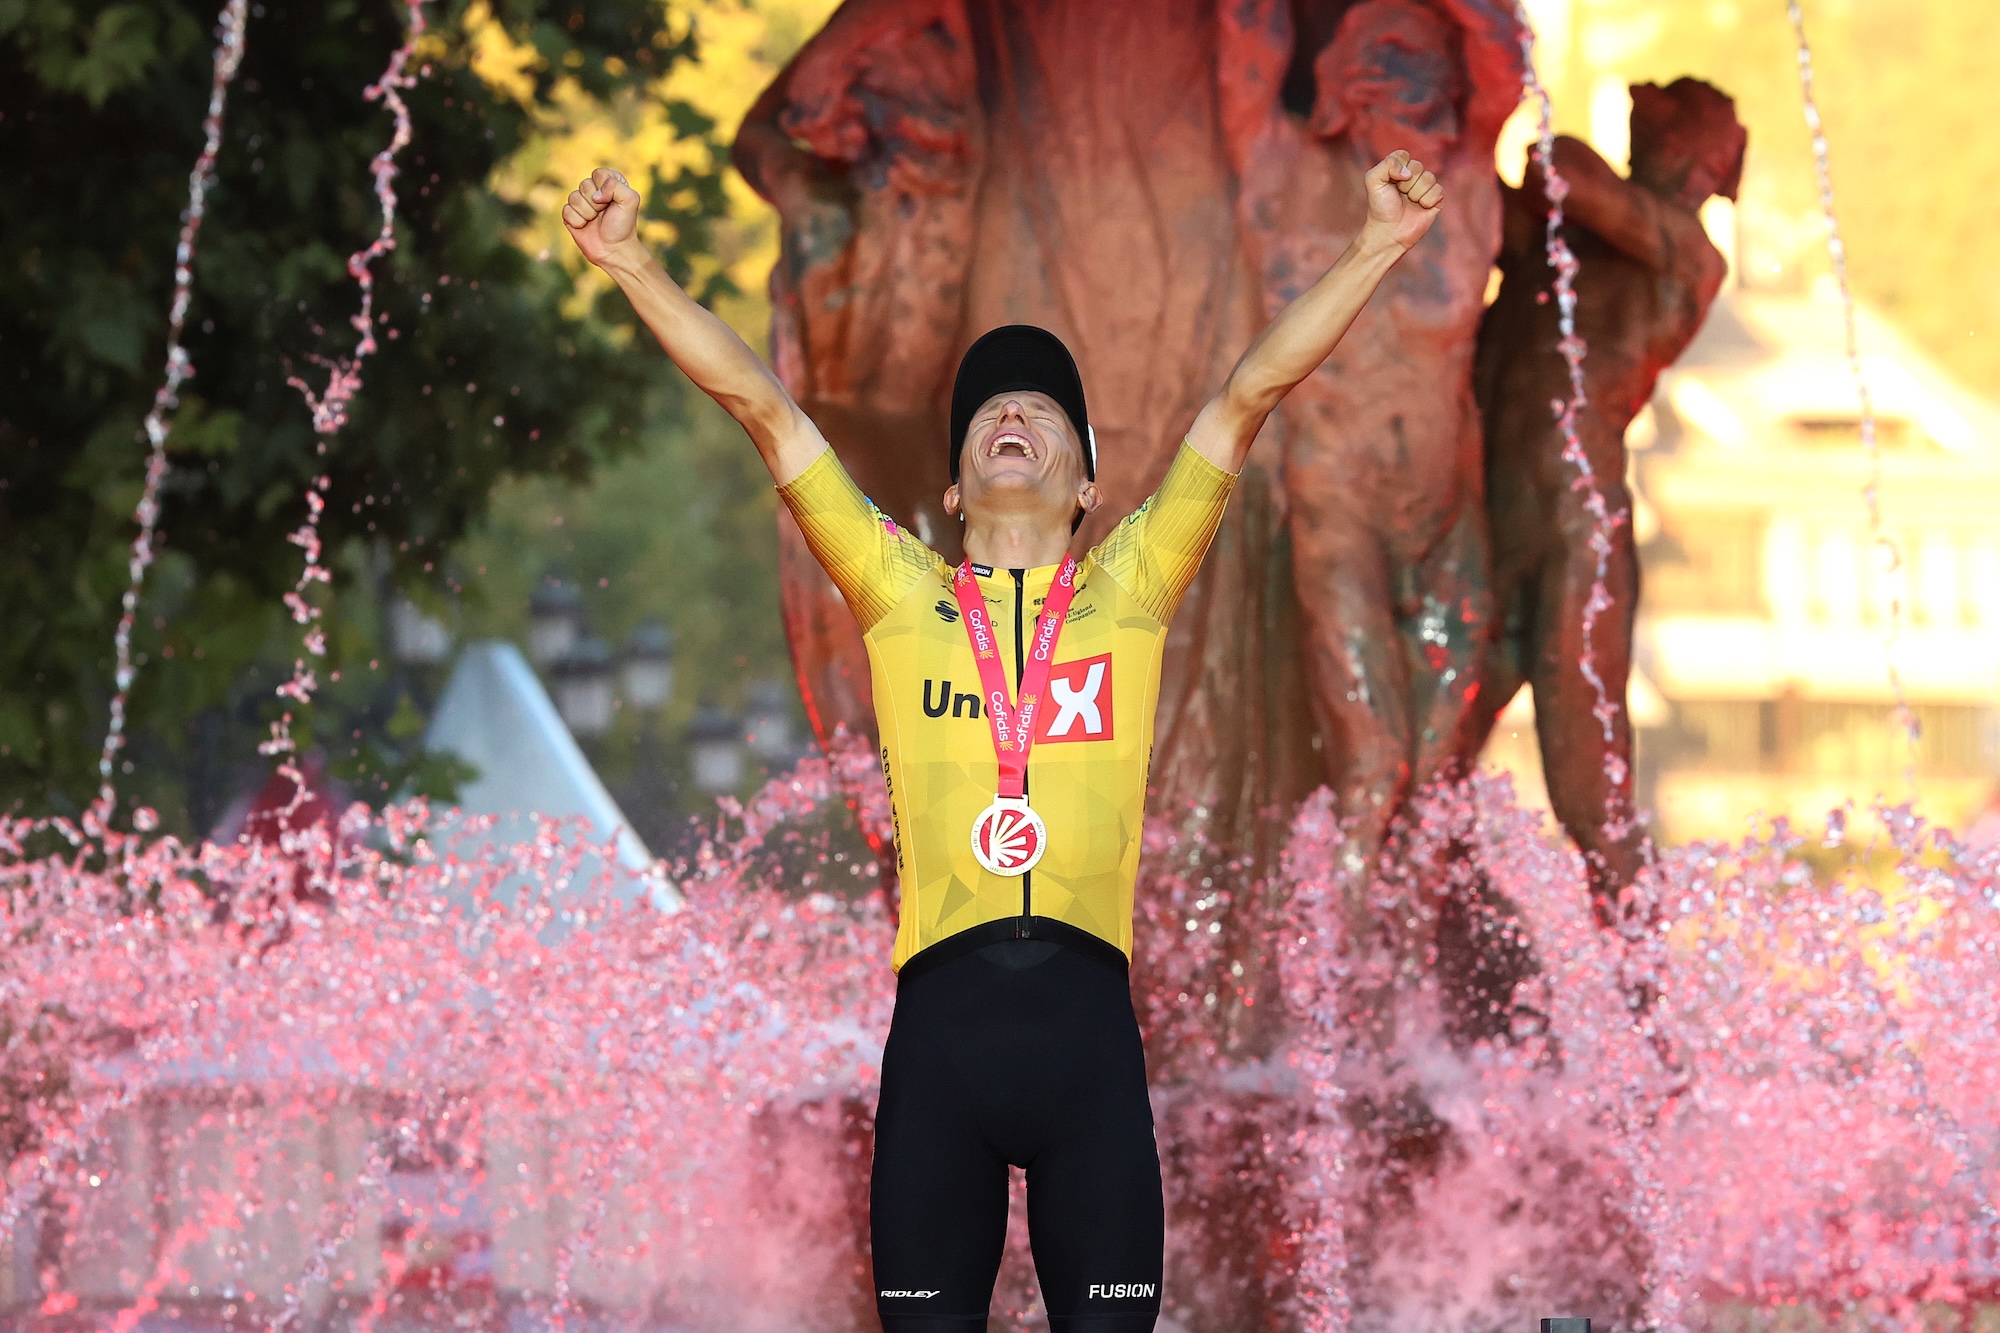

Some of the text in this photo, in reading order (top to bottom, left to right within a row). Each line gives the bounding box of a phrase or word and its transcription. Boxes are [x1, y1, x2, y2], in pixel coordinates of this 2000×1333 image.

[1065, 608, 1097, 625] Companies
[1072, 603, 1093, 616] Ugland
[969, 608, 990, 651] Cofidis
[1034, 618, 1057, 661] Cofidis
[923, 680, 1014, 719] Un
[991, 690, 1011, 742] Cofidis
[882, 745, 895, 799] 1000
[880, 1289, 941, 1299] RIDLEY
[1088, 1283, 1156, 1300] FUSION
